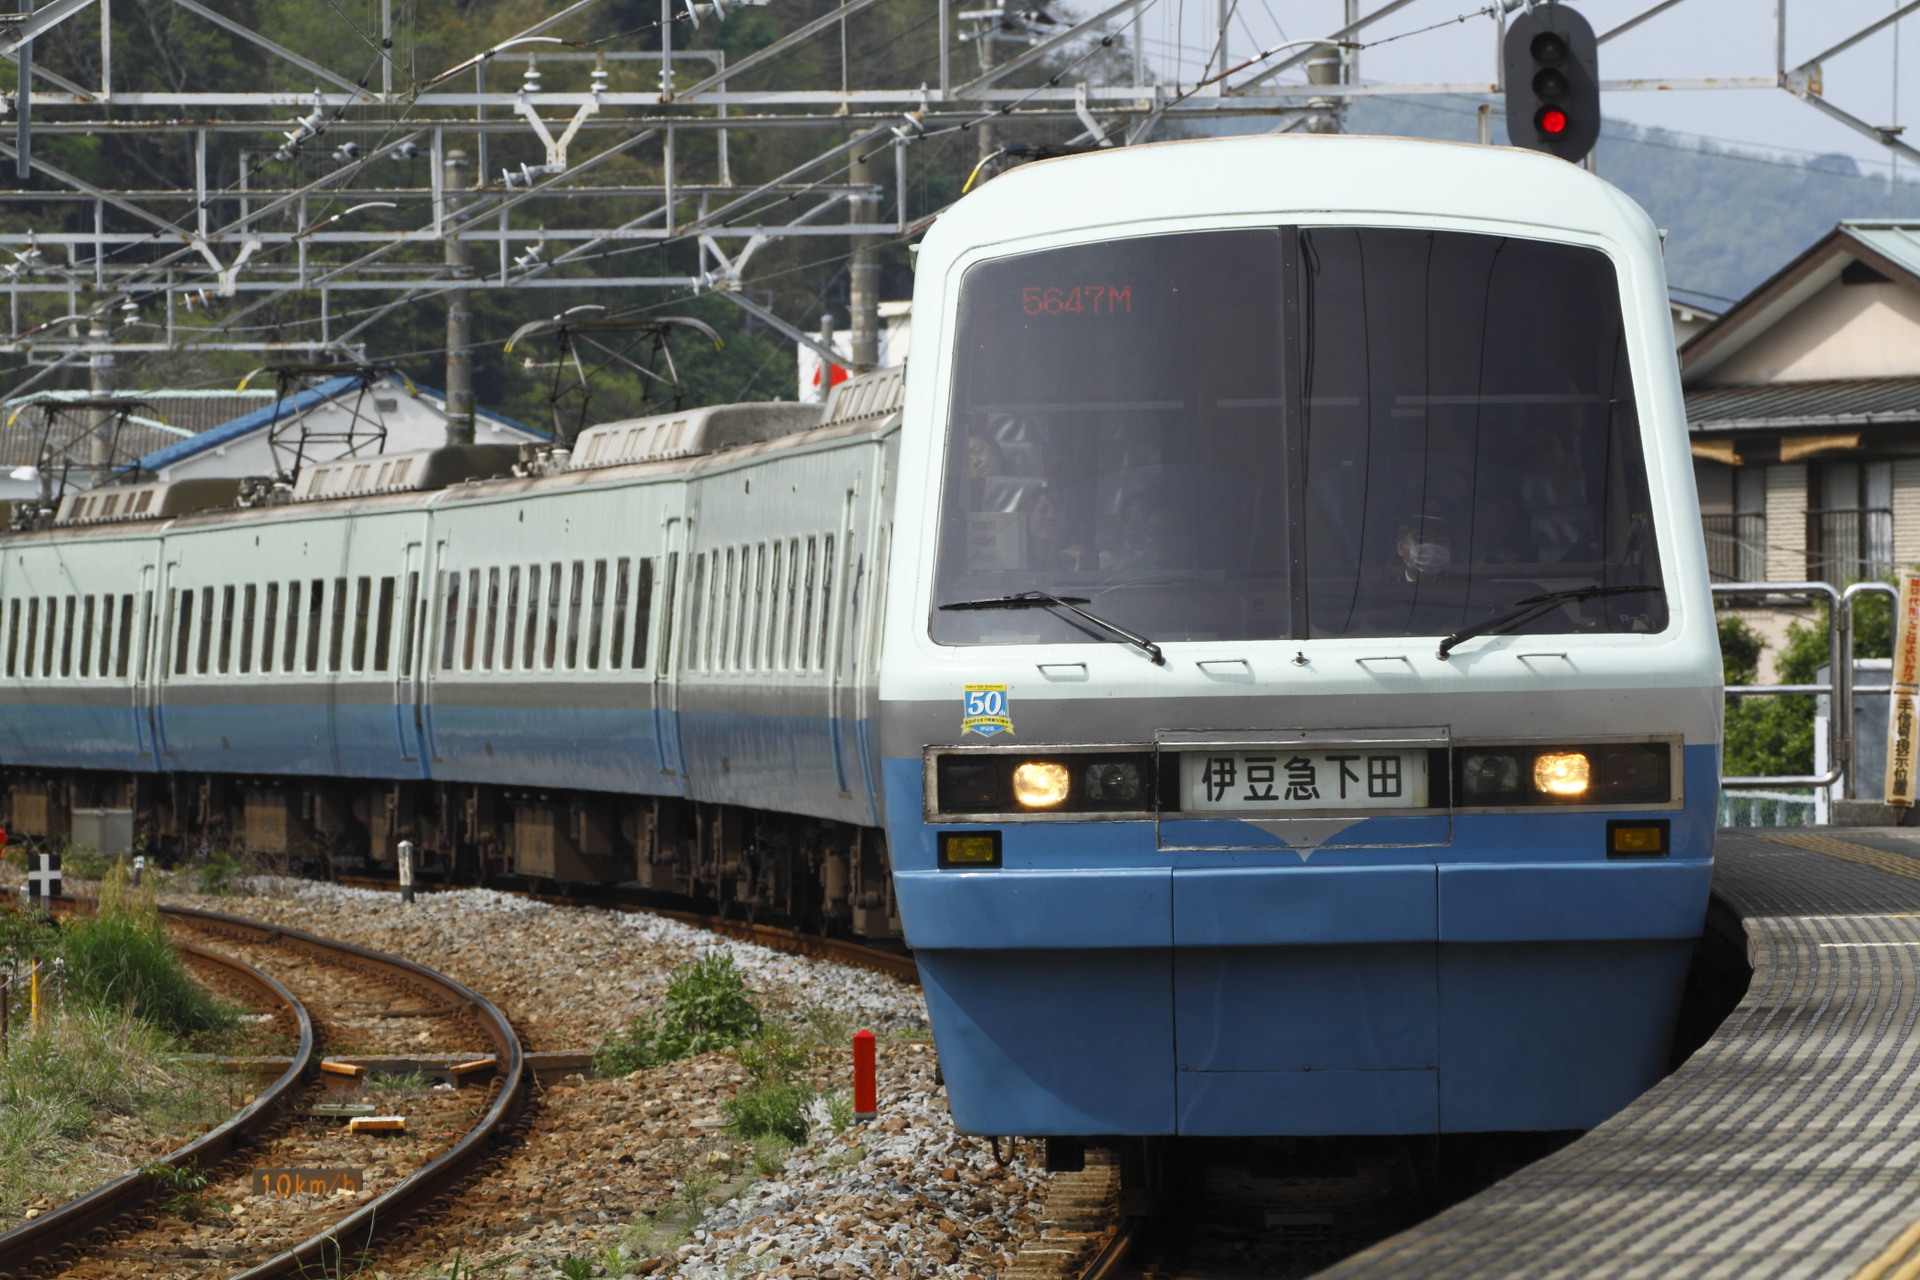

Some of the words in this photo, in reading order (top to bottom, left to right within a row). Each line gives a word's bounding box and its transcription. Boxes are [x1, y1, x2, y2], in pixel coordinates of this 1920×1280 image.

[1023, 285, 1132, 315] 5647M
[1202, 755, 1402, 802] 伊豆急下田
[262, 1173, 356, 1197] 10km/h
